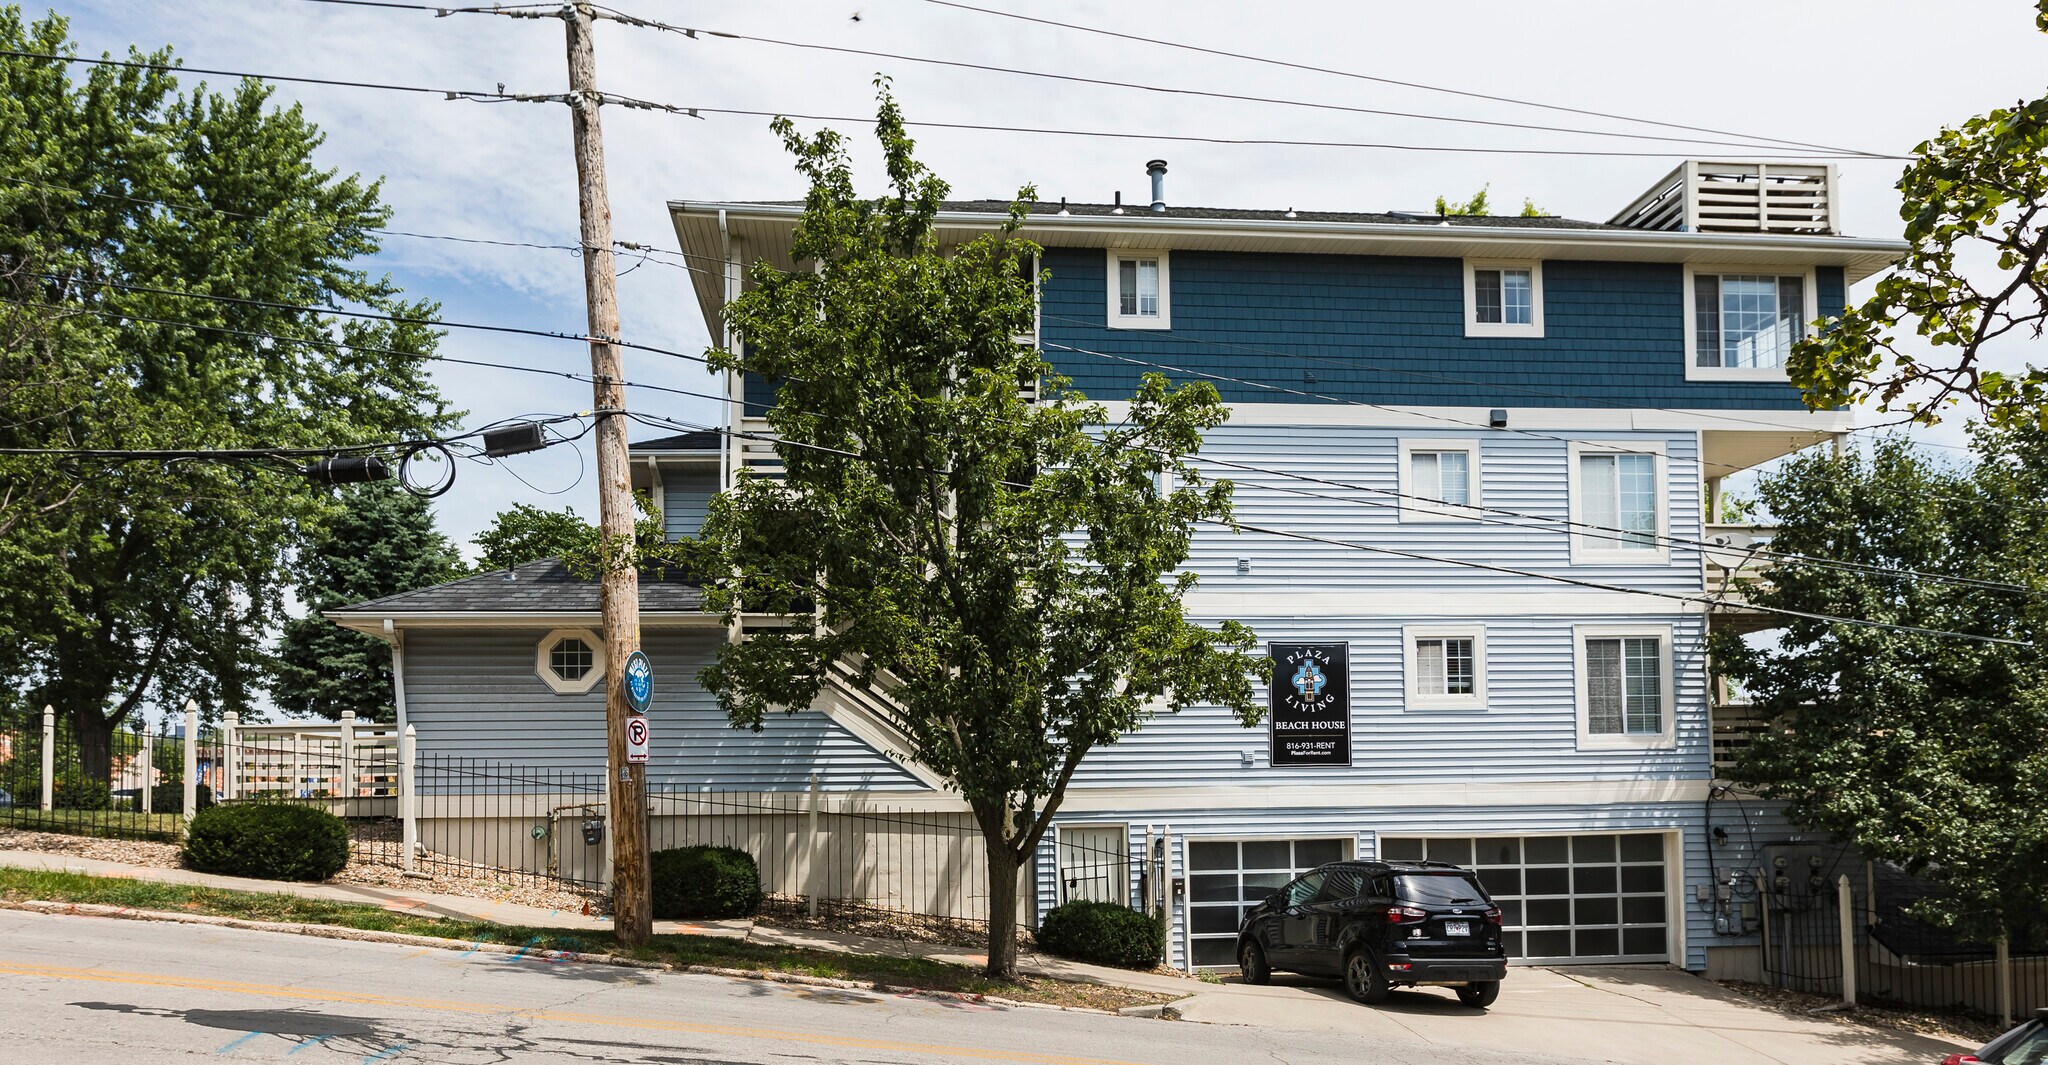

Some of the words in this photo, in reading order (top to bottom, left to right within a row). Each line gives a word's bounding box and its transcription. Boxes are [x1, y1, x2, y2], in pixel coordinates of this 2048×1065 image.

[1287, 649, 1330, 665] PLAZA
[1285, 693, 1335, 713] LIVING
[1275, 721, 1309, 730] BEACH
[1311, 720, 1346, 730] HOUSE
[1286, 741, 1336, 750] 816-931-RENT
